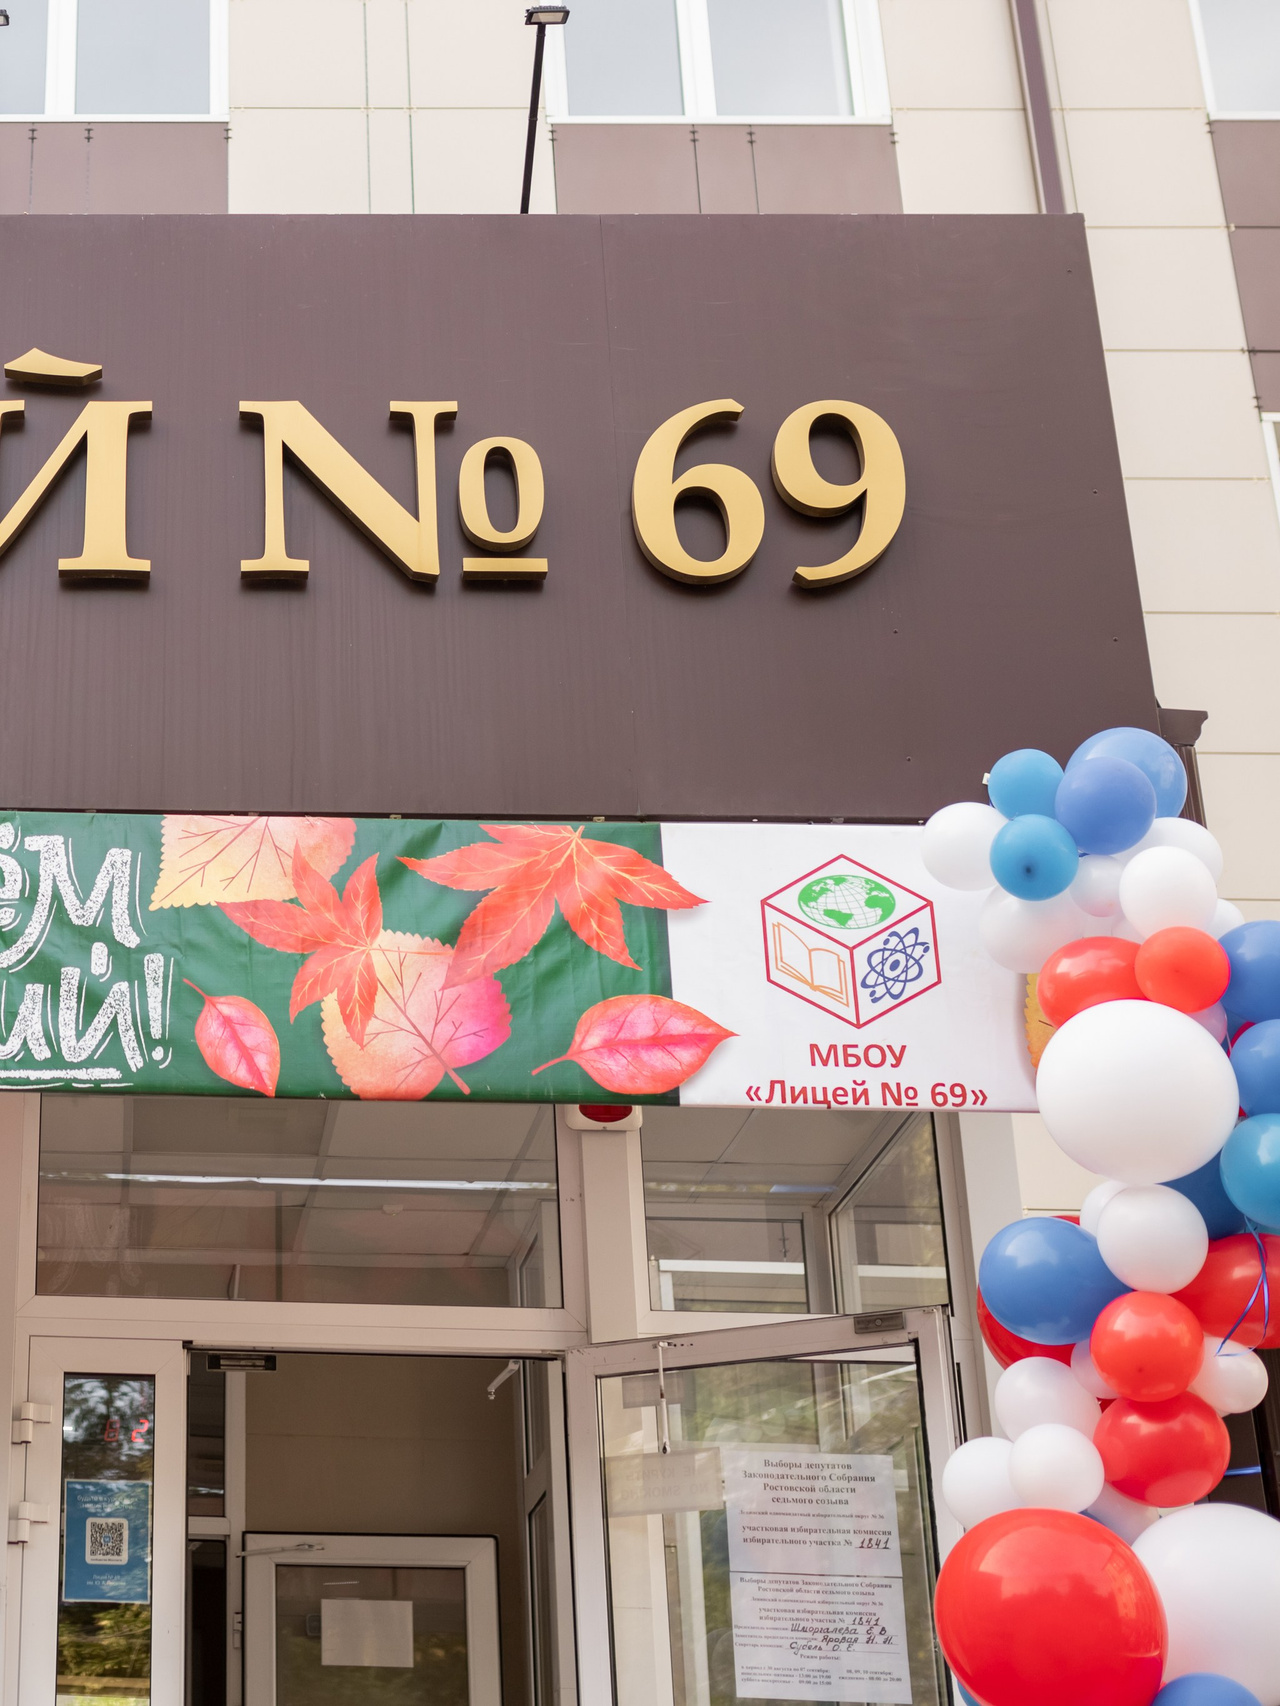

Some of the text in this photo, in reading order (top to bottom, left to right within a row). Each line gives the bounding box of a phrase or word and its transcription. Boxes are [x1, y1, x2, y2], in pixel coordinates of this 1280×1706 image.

[238, 399, 548, 582] №
[633, 398, 906, 589] 69
[809, 1043, 907, 1068] МБОУ
[745, 1079, 988, 1109] «Лицей № 69»
[763, 1459, 852, 1471] Выборы депутатов
[742, 1470, 876, 1483] Законодательного Собрания
[763, 1482, 856, 1494] Ростовской области
[771, 1496, 813, 1505] седьмого
[742, 1525, 892, 1536] участковая избирательная комиссия
[742, 1536, 807, 1546] избирательного
[808, 1539, 842, 1547] участка
[859, 1537, 890, 1550] 1841
[739, 1577, 767, 1585] Выборы
[795, 1587, 821, 1595] области
[758, 1606, 795, 1615] участковая
